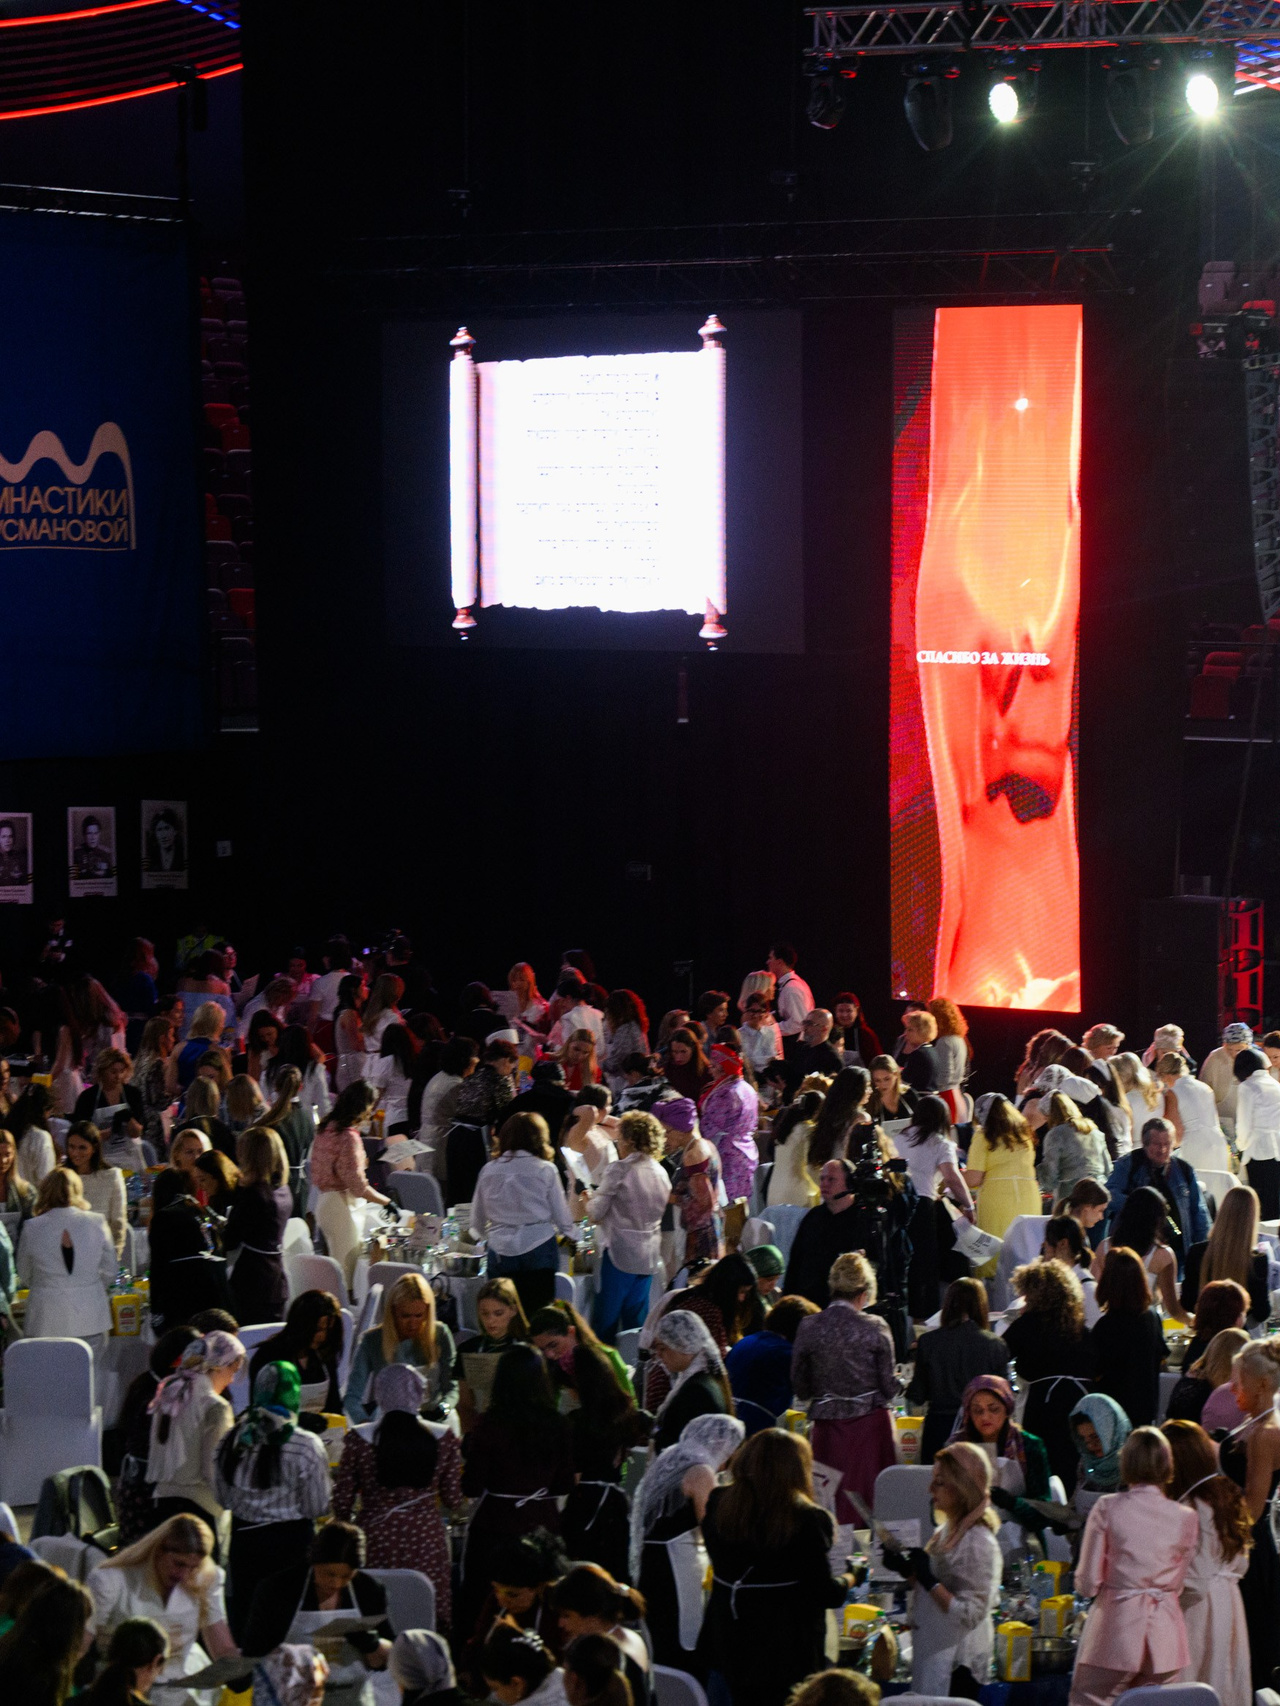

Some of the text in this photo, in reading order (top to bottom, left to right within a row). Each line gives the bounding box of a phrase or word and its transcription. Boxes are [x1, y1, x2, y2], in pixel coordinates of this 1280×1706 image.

[0, 517, 129, 543] СМАНОВОЙ
[916, 650, 1051, 666] СПАСИБО ЗА ЖИЗНЬ
